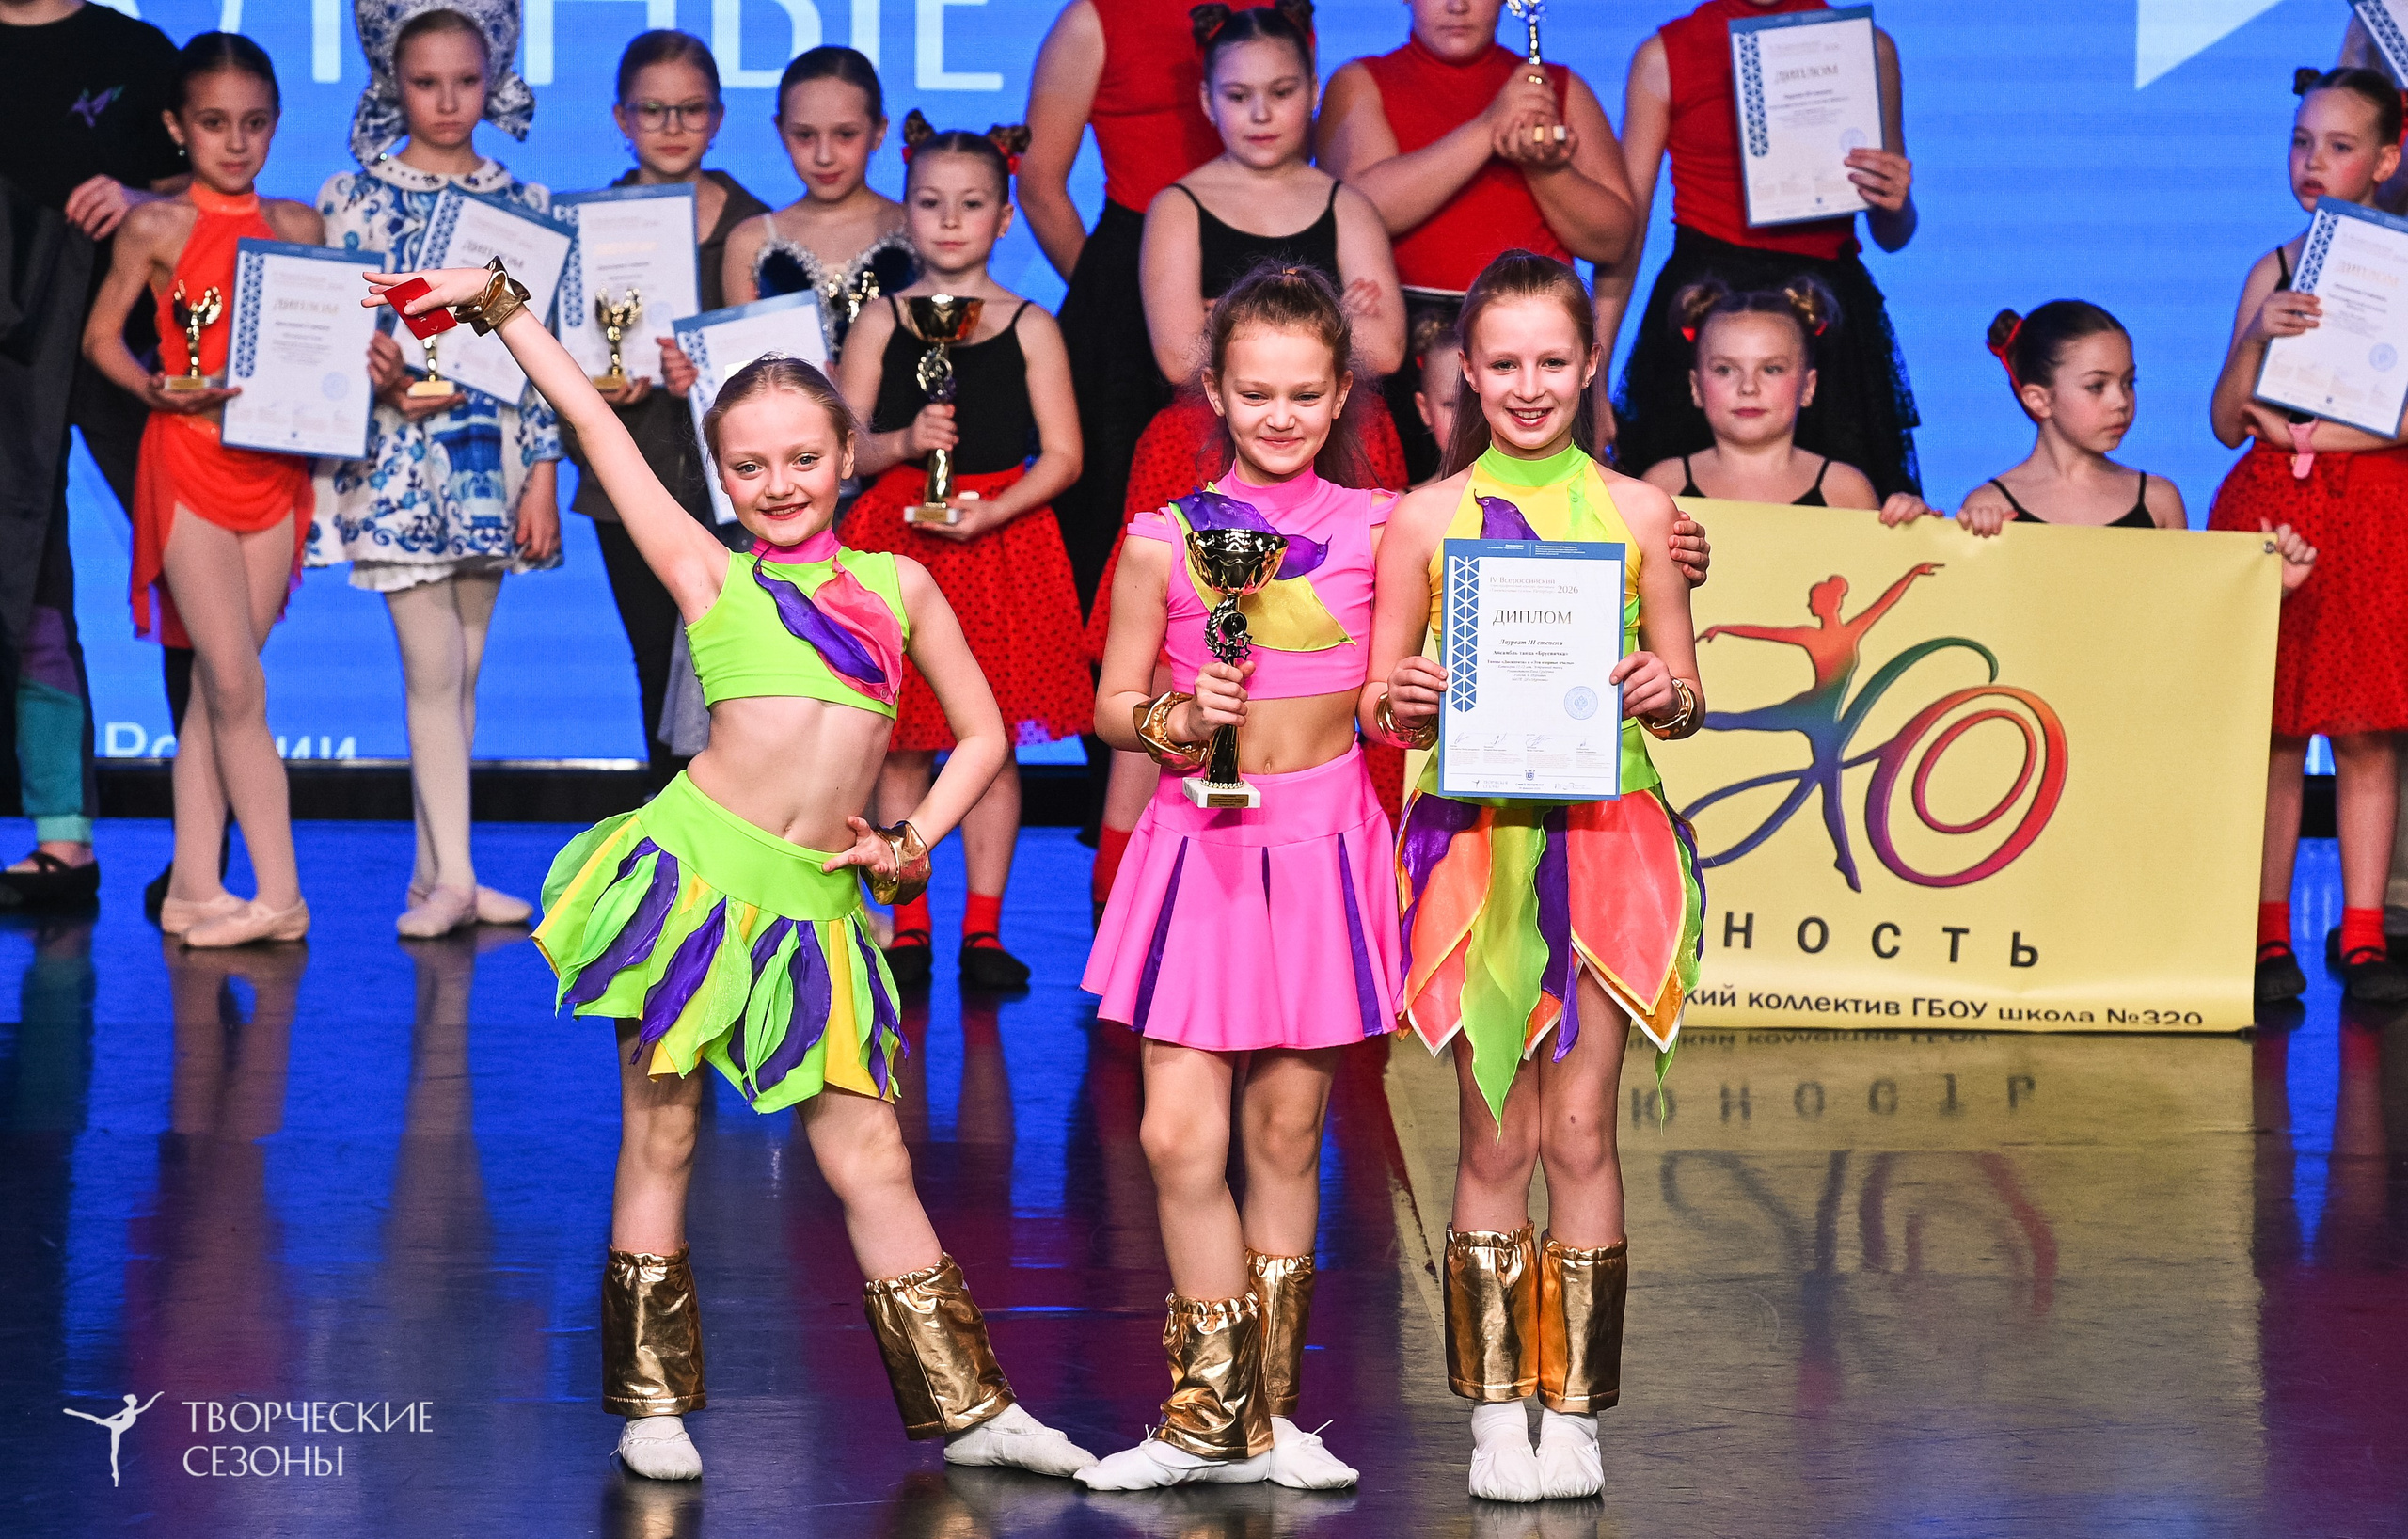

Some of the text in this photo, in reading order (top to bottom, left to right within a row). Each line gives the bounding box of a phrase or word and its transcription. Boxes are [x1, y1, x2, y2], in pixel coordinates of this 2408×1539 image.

[1557, 585, 1579, 595] 2026
[1492, 610, 1573, 626] ДИПЛОМ
[1723, 911, 2039, 968] НОСТЬ
[1685, 983, 1736, 1007] кий
[1748, 991, 1901, 1016] коллектив
[1912, 997, 1988, 1020] ГБОУ
[1998, 1007, 2095, 1023] школа
